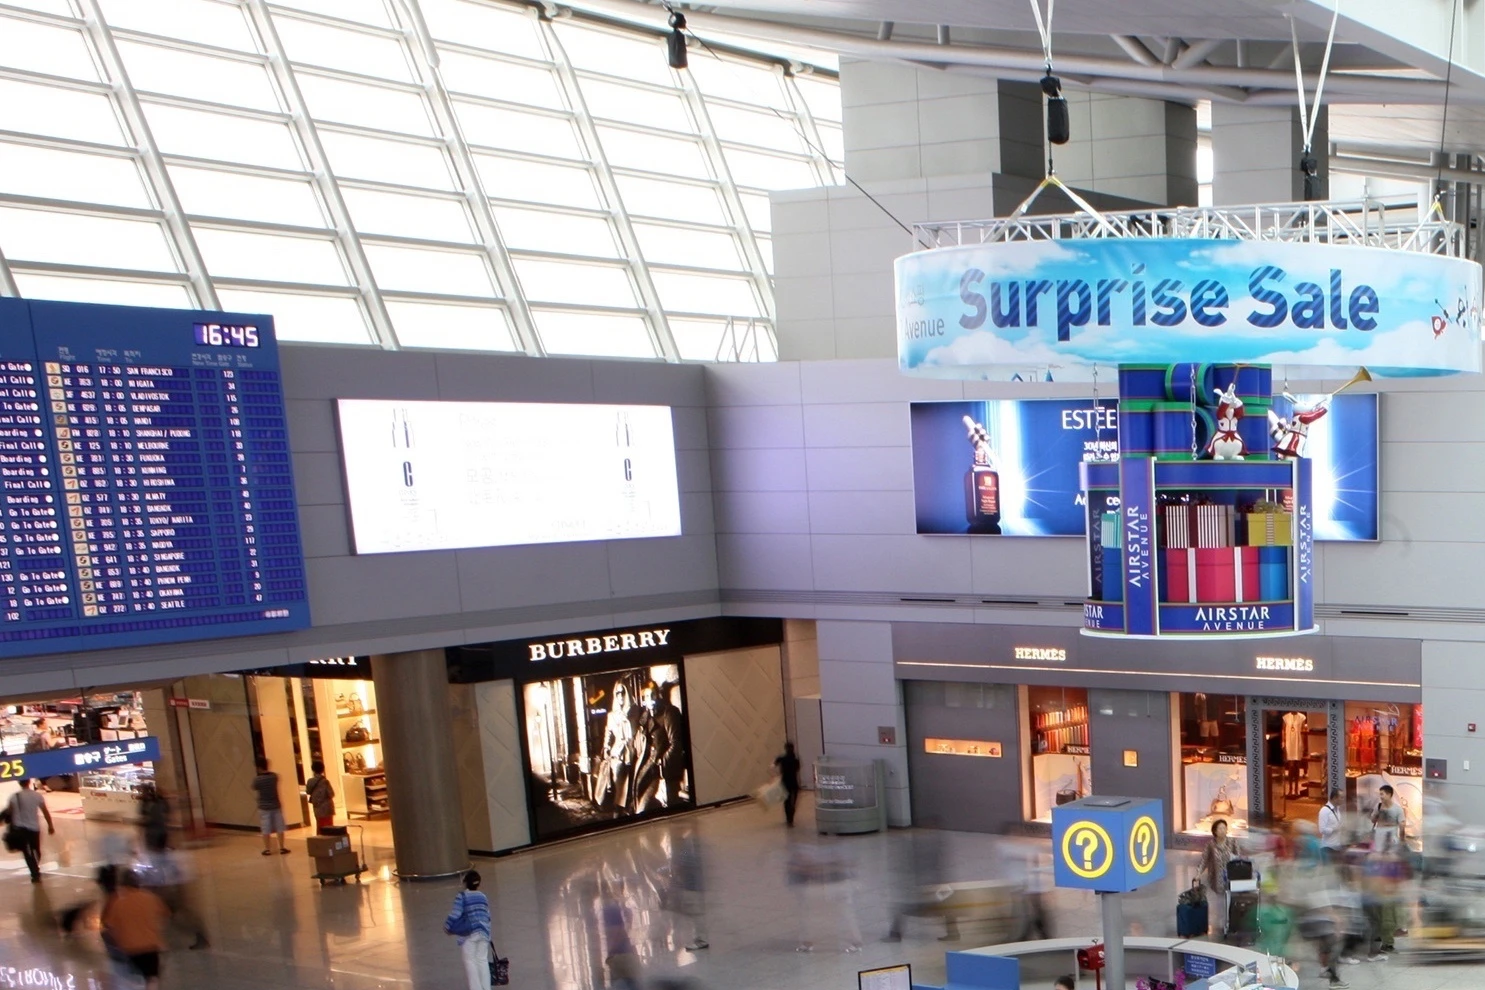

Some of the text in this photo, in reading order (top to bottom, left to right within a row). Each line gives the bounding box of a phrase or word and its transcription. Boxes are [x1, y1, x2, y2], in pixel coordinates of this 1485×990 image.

[958, 263, 1230, 341] Surprise
[1247, 266, 1380, 331] Sale
[201, 325, 259, 347] 16:45
[1127, 505, 1141, 587] AIRSTAR
[1140, 513, 1149, 580] AVENUE
[1195, 607, 1270, 621] AIRSTAR
[1203, 621, 1264, 630] AVENUE
[529, 629, 672, 662] BURBERRY
[104, 755, 127, 764] Gates
